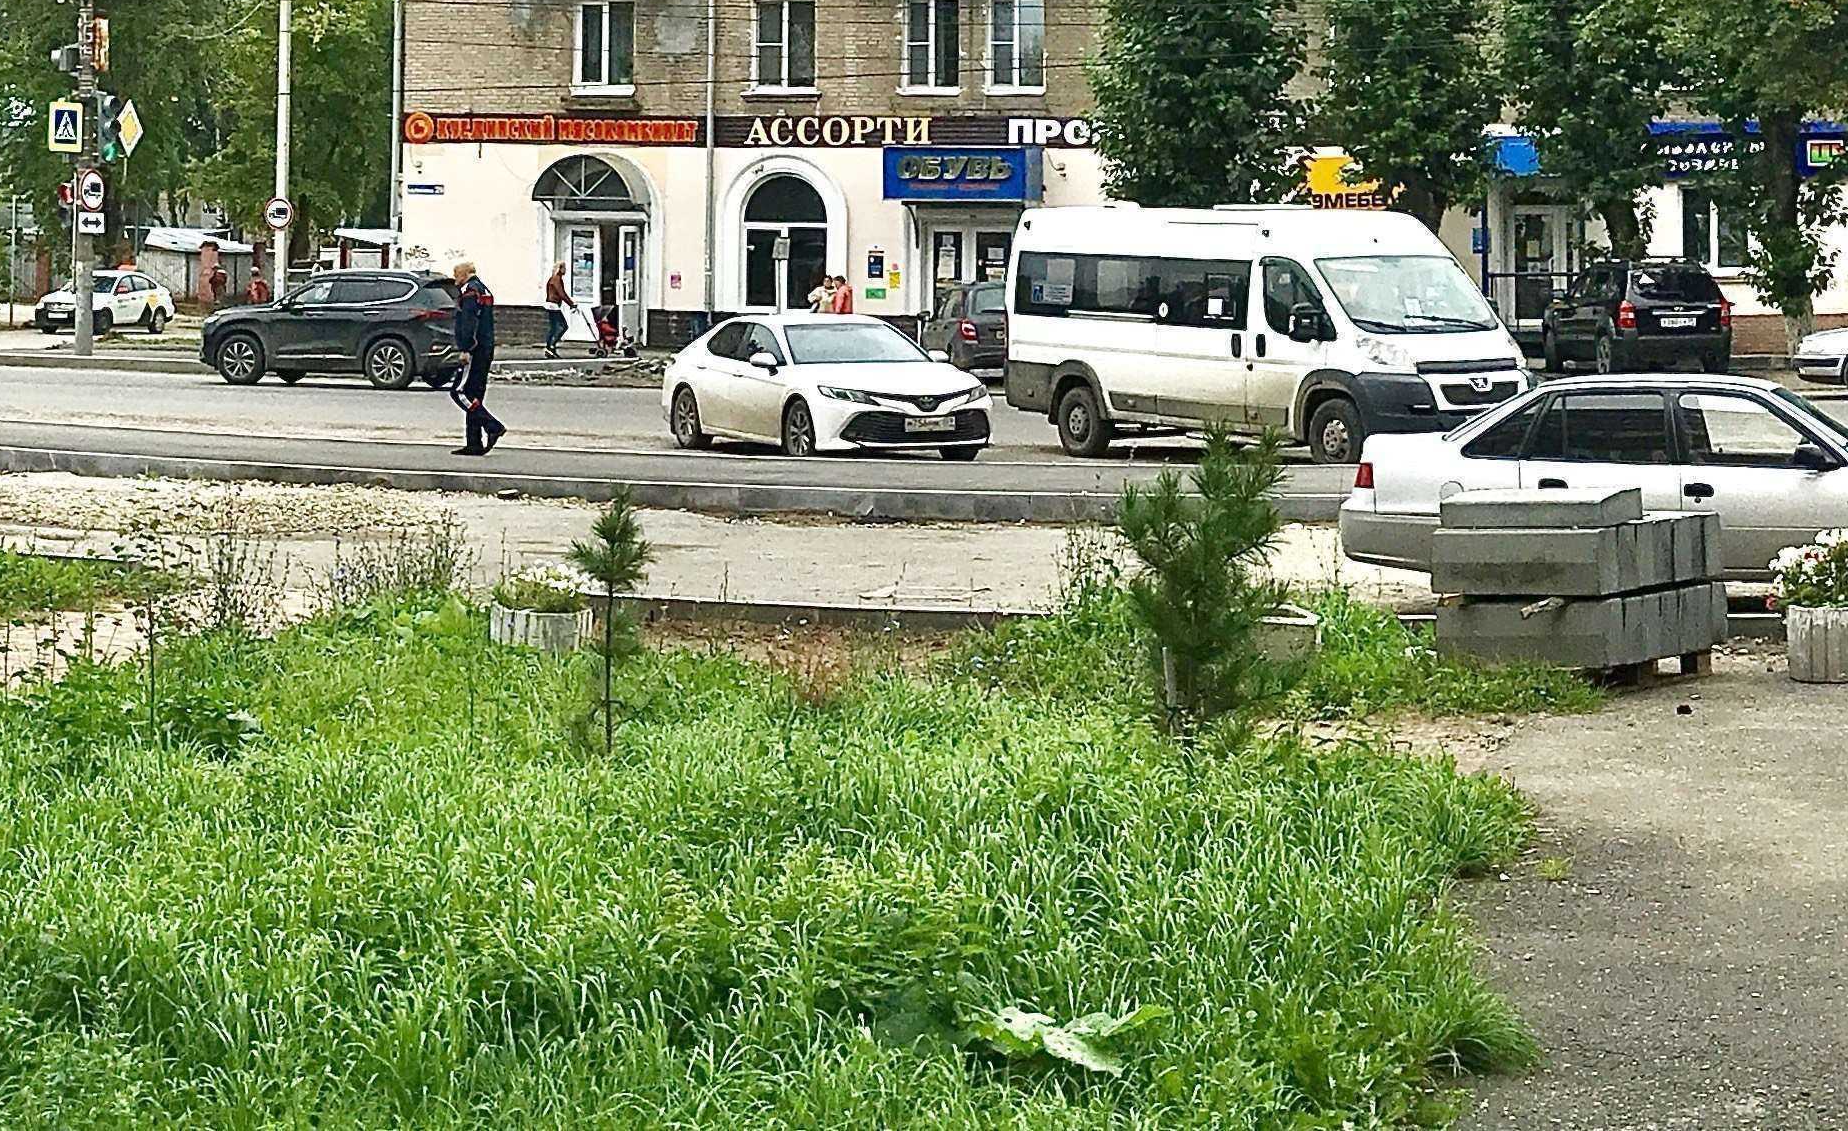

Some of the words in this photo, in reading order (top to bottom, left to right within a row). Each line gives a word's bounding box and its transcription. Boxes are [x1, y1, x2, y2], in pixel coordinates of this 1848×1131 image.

[744, 117, 932, 146] АССОРТИ
[1008, 119, 1103, 146] ПРО
[897, 155, 1011, 180] ОБУВЬ
